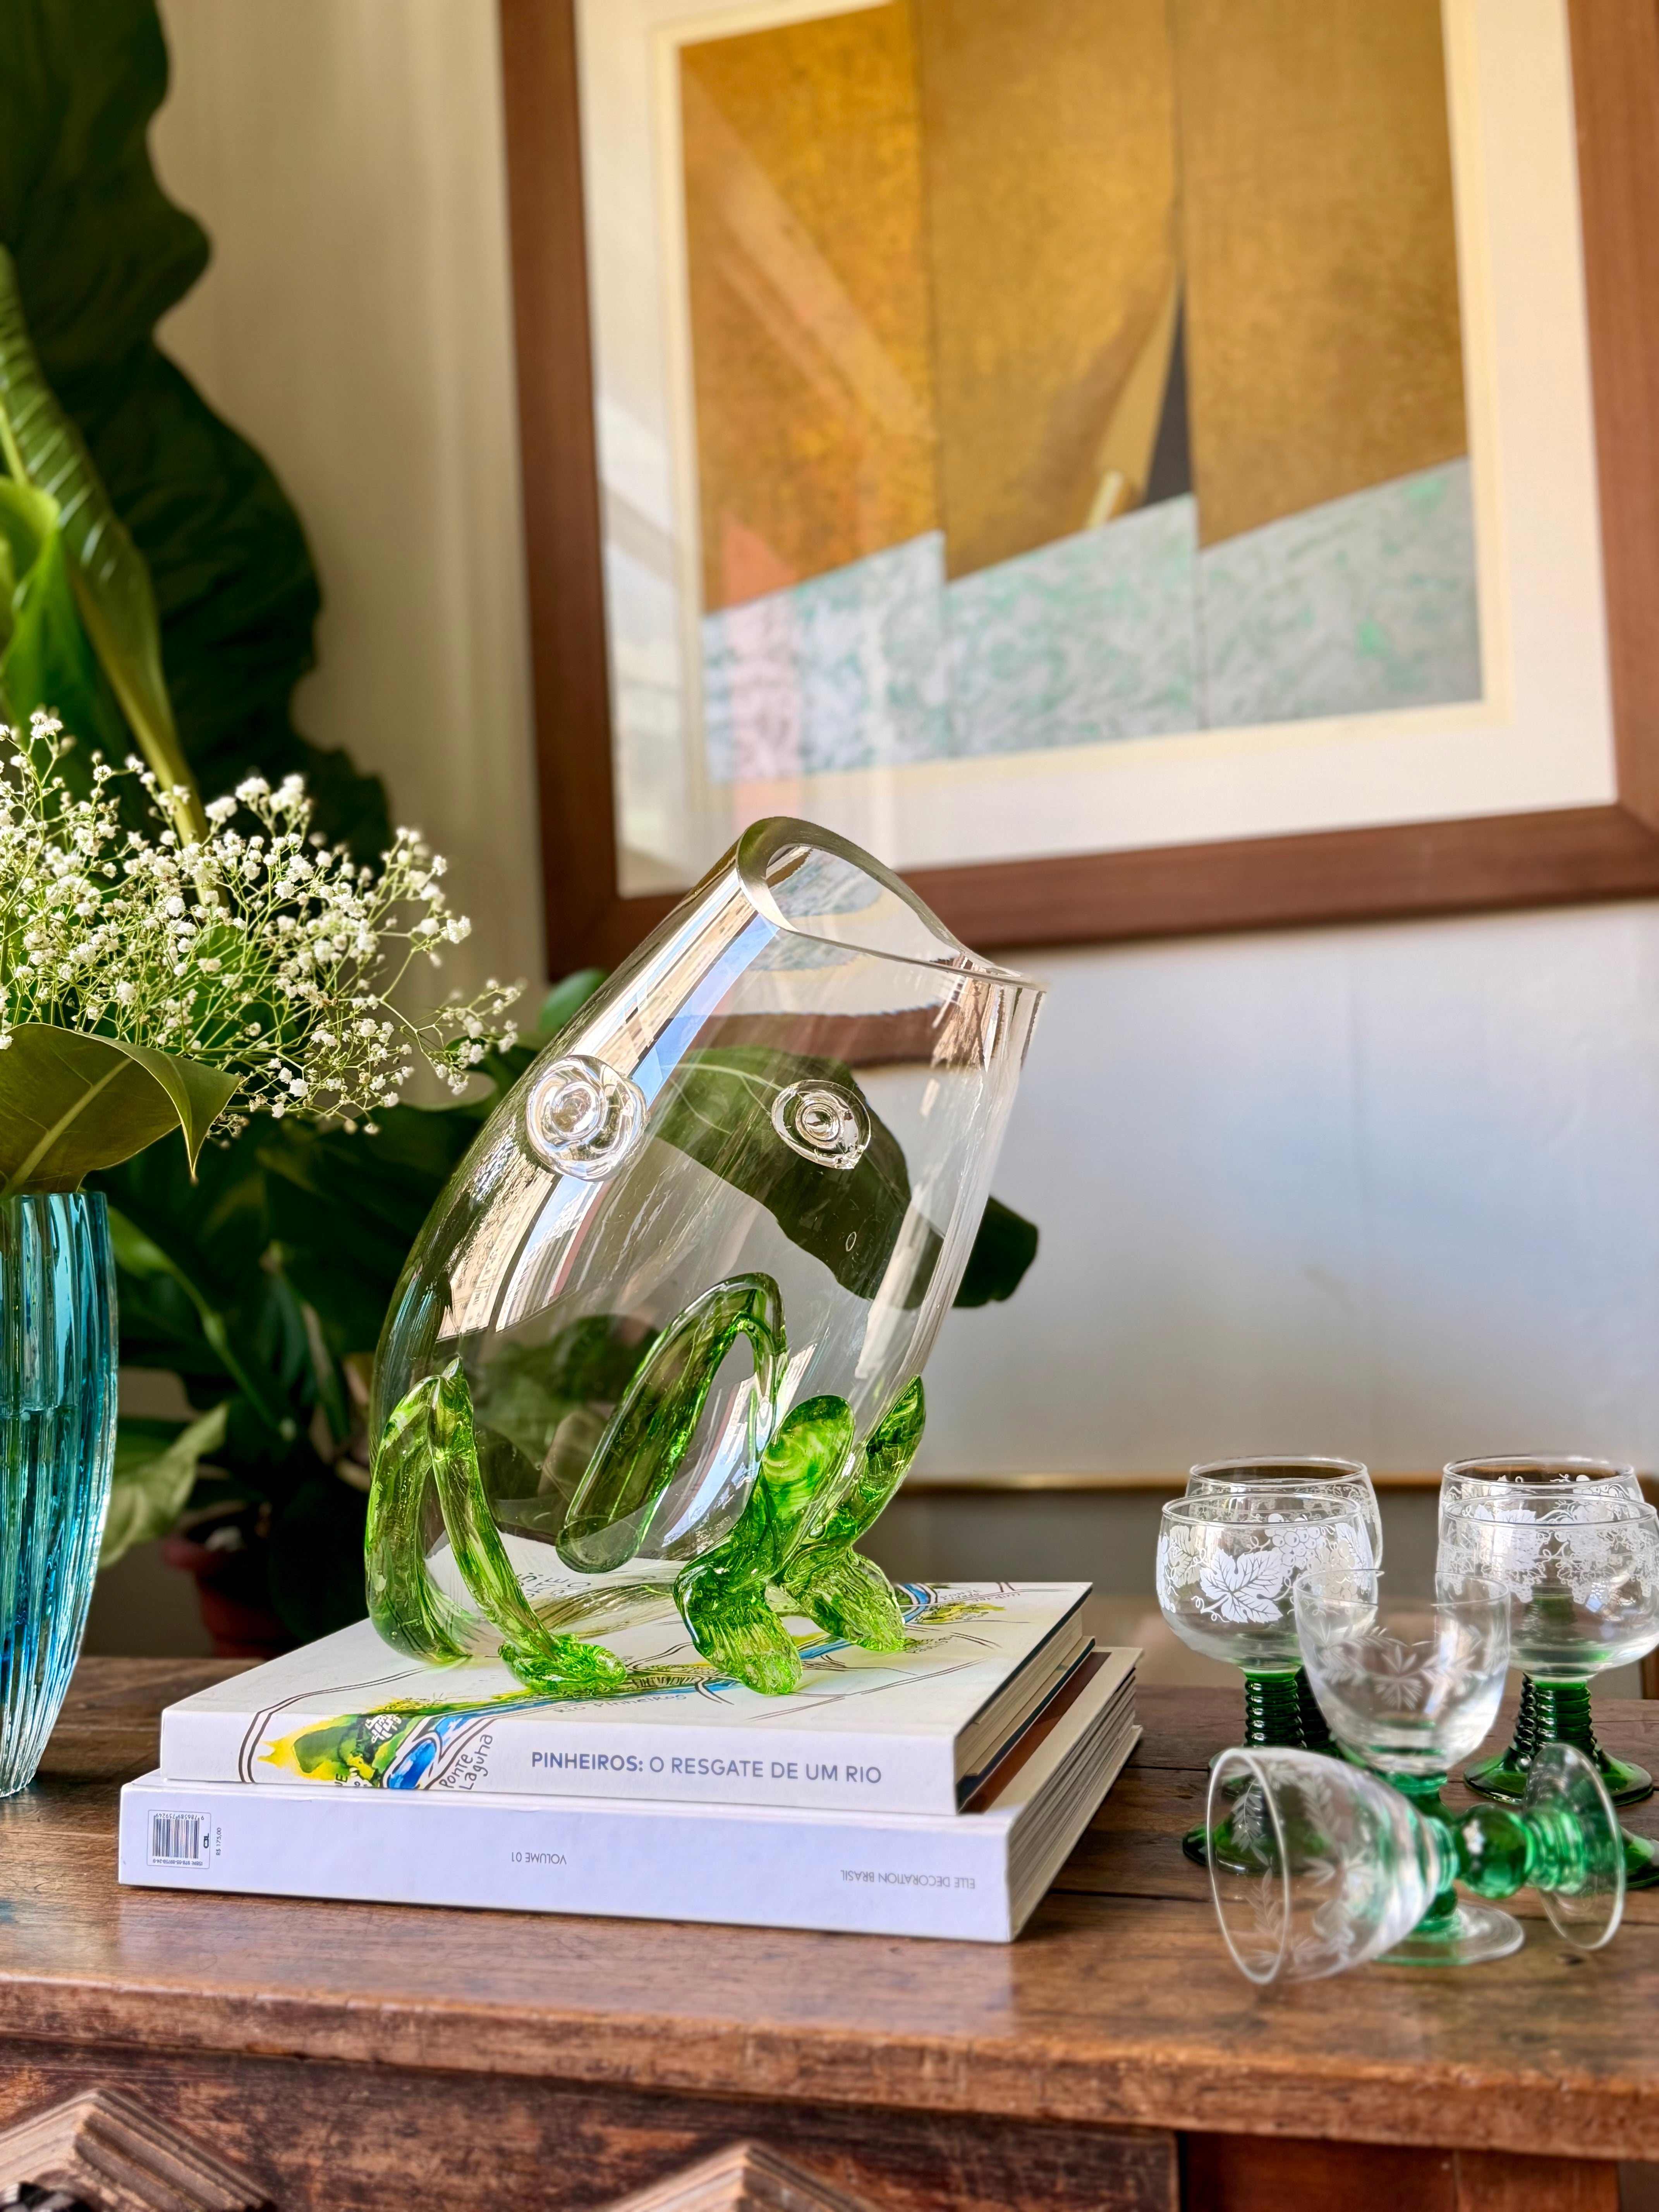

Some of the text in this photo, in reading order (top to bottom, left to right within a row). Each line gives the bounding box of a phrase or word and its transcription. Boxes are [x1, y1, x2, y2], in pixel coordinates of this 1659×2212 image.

[531, 1751, 882, 1784] PINHEIROS: O RESGATE DE UM RIO
[512, 1852, 567, 1865] VOLUME 01
[840, 1870, 975, 1889] ELLE DECORATION BRASIL
